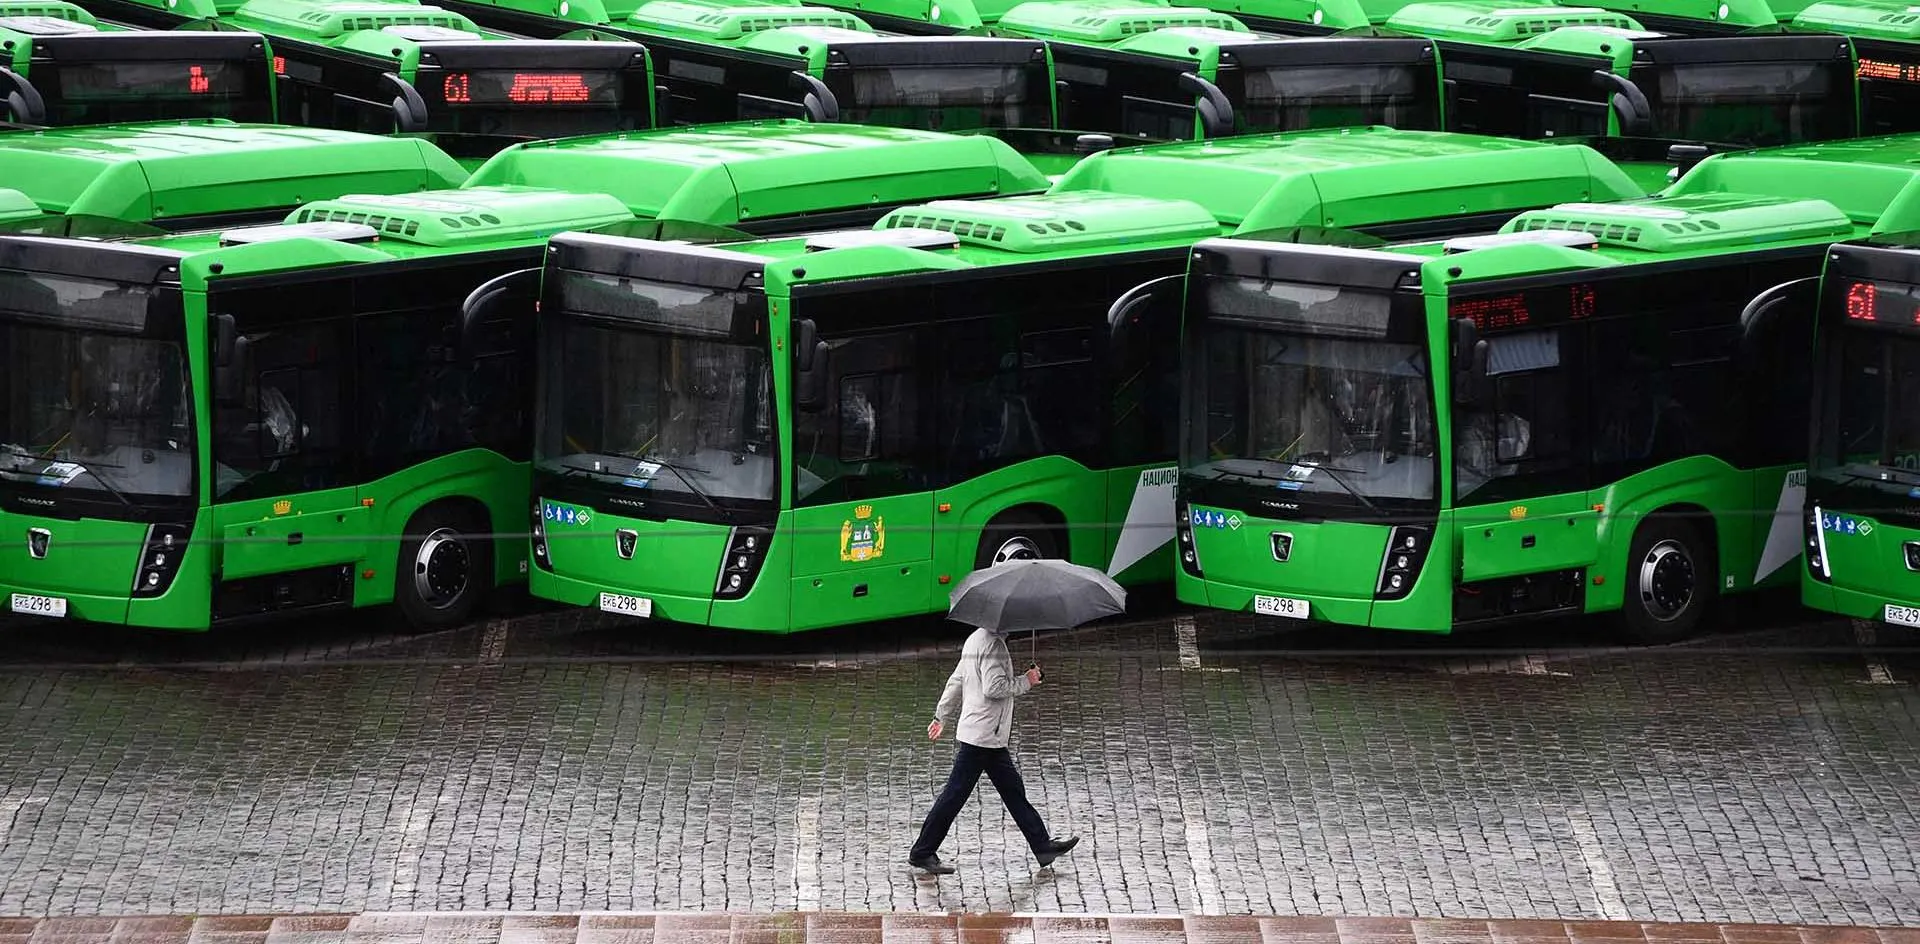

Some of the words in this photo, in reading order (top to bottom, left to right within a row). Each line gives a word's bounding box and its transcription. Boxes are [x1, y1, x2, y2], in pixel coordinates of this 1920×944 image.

[445, 73, 471, 101] 61
[1848, 283, 1875, 320] 61
[1143, 469, 1178, 487] НАЦИОН
